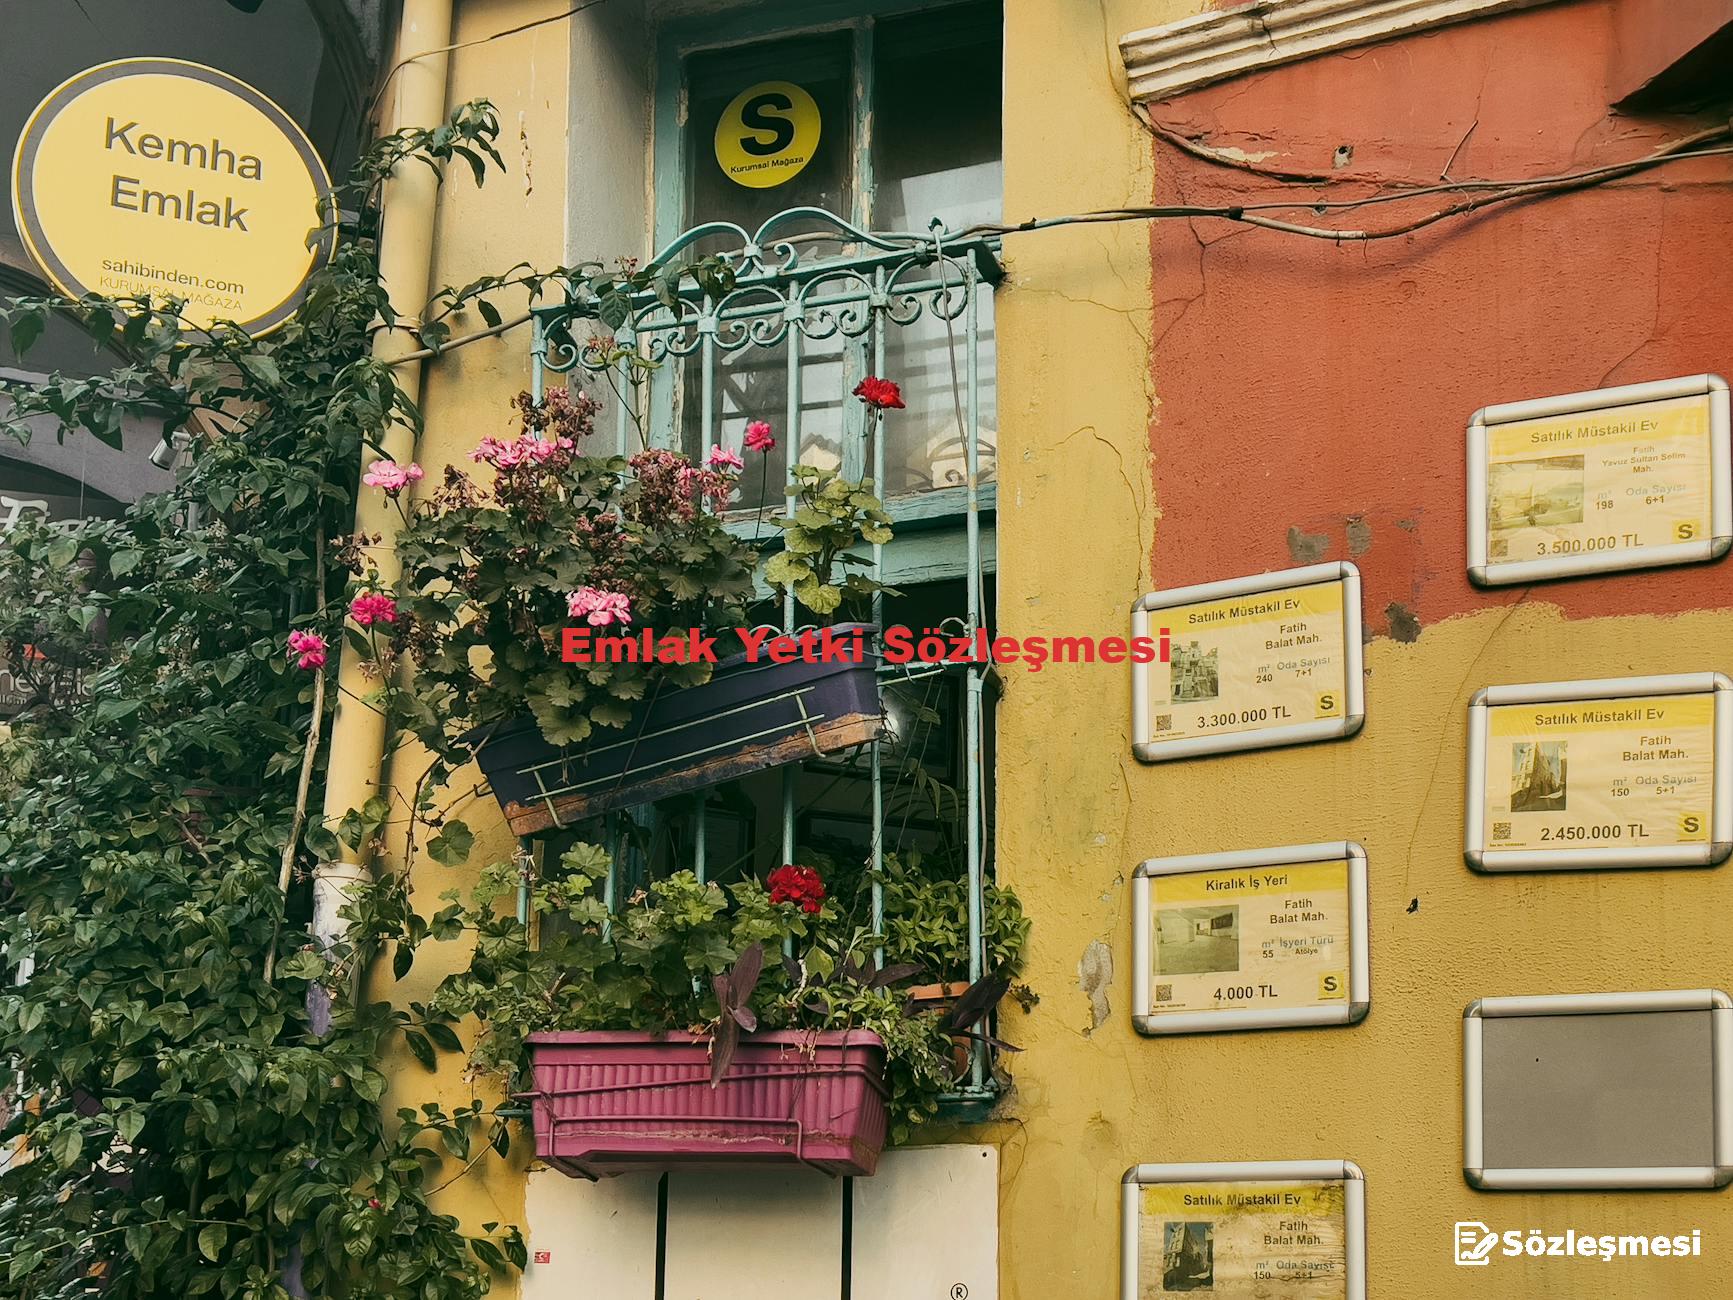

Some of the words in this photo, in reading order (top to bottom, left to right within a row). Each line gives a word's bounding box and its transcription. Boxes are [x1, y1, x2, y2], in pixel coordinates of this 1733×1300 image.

[740, 92, 794, 156] S
[105, 117, 263, 181] Kemha
[730, 161, 770, 174] Kurumsal
[771, 157, 804, 167] Mağaza
[110, 175, 249, 232] Emlak
[102, 259, 244, 294] sahibinden.com
[181, 291, 243, 312] MAĞAZA
[1531, 430, 1573, 444] Satılık
[1577, 422, 1636, 439] Müstakil
[1640, 420, 1659, 431] Ev
[1633, 465, 1654, 473] Mah.
[1626, 487, 1648, 496] Oda
[1596, 500, 1614, 510] 198
[1645, 495, 1664, 504] 6+1
[1678, 524, 1693, 539] S
[1537, 535, 1616, 556] 3.500.000
[1622, 534, 1644, 547] TL
[1188, 610, 1226, 625] Satılık
[1229, 601, 1281, 618] Müstakil
[1285, 599, 1300, 610] Ev
[1280, 622, 1307, 634] Fatih
[1266, 636, 1294, 650] Balat
[1296, 634, 1323, 646] Mah.
[1277, 661, 1297, 670] Oda
[1256, 673, 1273, 684] 240
[1295, 668, 1312, 678] 7+1
[1320, 695, 1334, 710] S
[1197, 708, 1267, 729] 3.300.000
[1272, 705, 1292, 718] TL
[1535, 713, 1578, 726] Satılık
[1582, 709, 1642, 723] Müstakil
[1646, 708, 1665, 720] Ev
[1640, 735, 1671, 747] Fatih
[1623, 750, 1655, 762] Balat
[1659, 748, 1689, 760] Mah.
[1635, 776, 1658, 785] Oda
[1611, 787, 1630, 797] 150
[1656, 786, 1675, 795] 5+1
[1684, 817, 1699, 832] S
[1541, 825, 1621, 841] 2.450.000
[1628, 824, 1649, 837] TL
[1206, 878, 1245, 891] Kiralık
[1250, 875, 1260, 889] İş
[1264, 874, 1288, 887] Yeri
[1284, 899, 1312, 910] Fatih
[1270, 913, 1298, 925] Balat
[1301, 911, 1328, 922] Mah.
[1310, 935, 1334, 945] Türü
[1262, 950, 1274, 959] 55
[1323, 976, 1337, 991] S
[1213, 986, 1253, 1001] 4.000
[1259, 984, 1278, 998] TL
[1184, 1194, 1223, 1206] Satılık
[1227, 1193, 1280, 1206] Müstakil
[1285, 1194, 1301, 1205] Ev
[1280, 1221, 1308, 1231] Fatih
[1264, 1234, 1292, 1245] Balat
[1296, 1234, 1324, 1245] Mah.
[1276, 1259, 1297, 1269] Oda
[1254, 1271, 1271, 1280] 150
